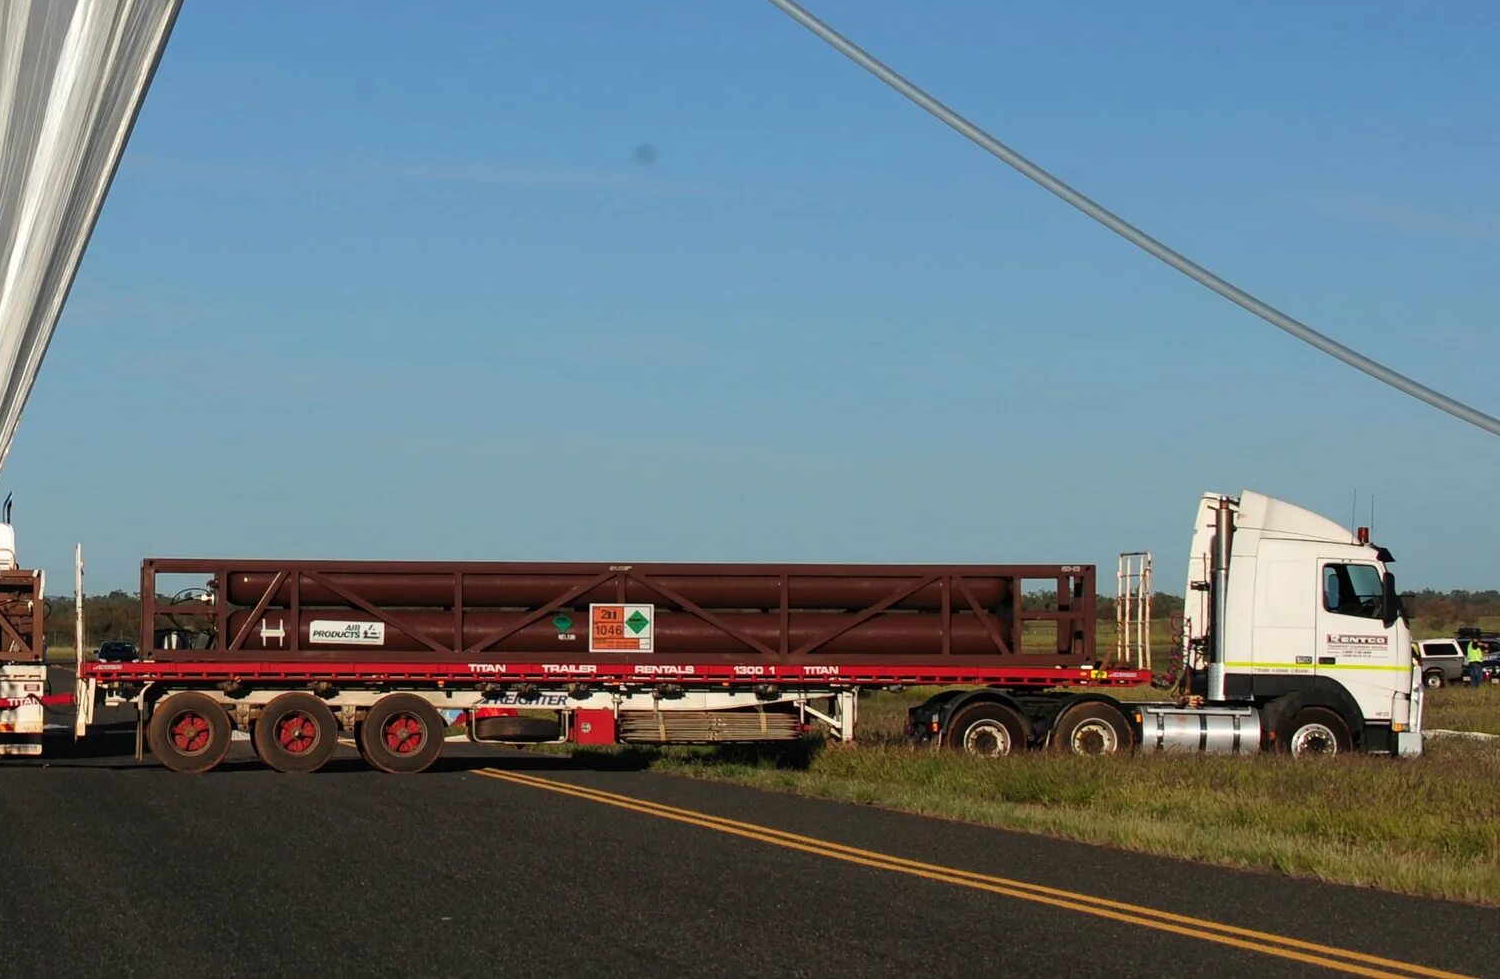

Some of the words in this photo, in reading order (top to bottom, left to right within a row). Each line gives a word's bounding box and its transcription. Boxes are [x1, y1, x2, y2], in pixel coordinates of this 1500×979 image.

[312, 630, 361, 639] PRODUCTS
[595, 625, 623, 636] 1046
[1329, 634, 1386, 644] RENTCO
[467, 664, 506, 673] TITAN
[541, 664, 597, 673] TRAILER
[634, 665, 695, 675] RENTALS
[733, 666, 764, 675] 1300
[768, 666, 776, 675] 1
[803, 666, 839, 675] TITAN
